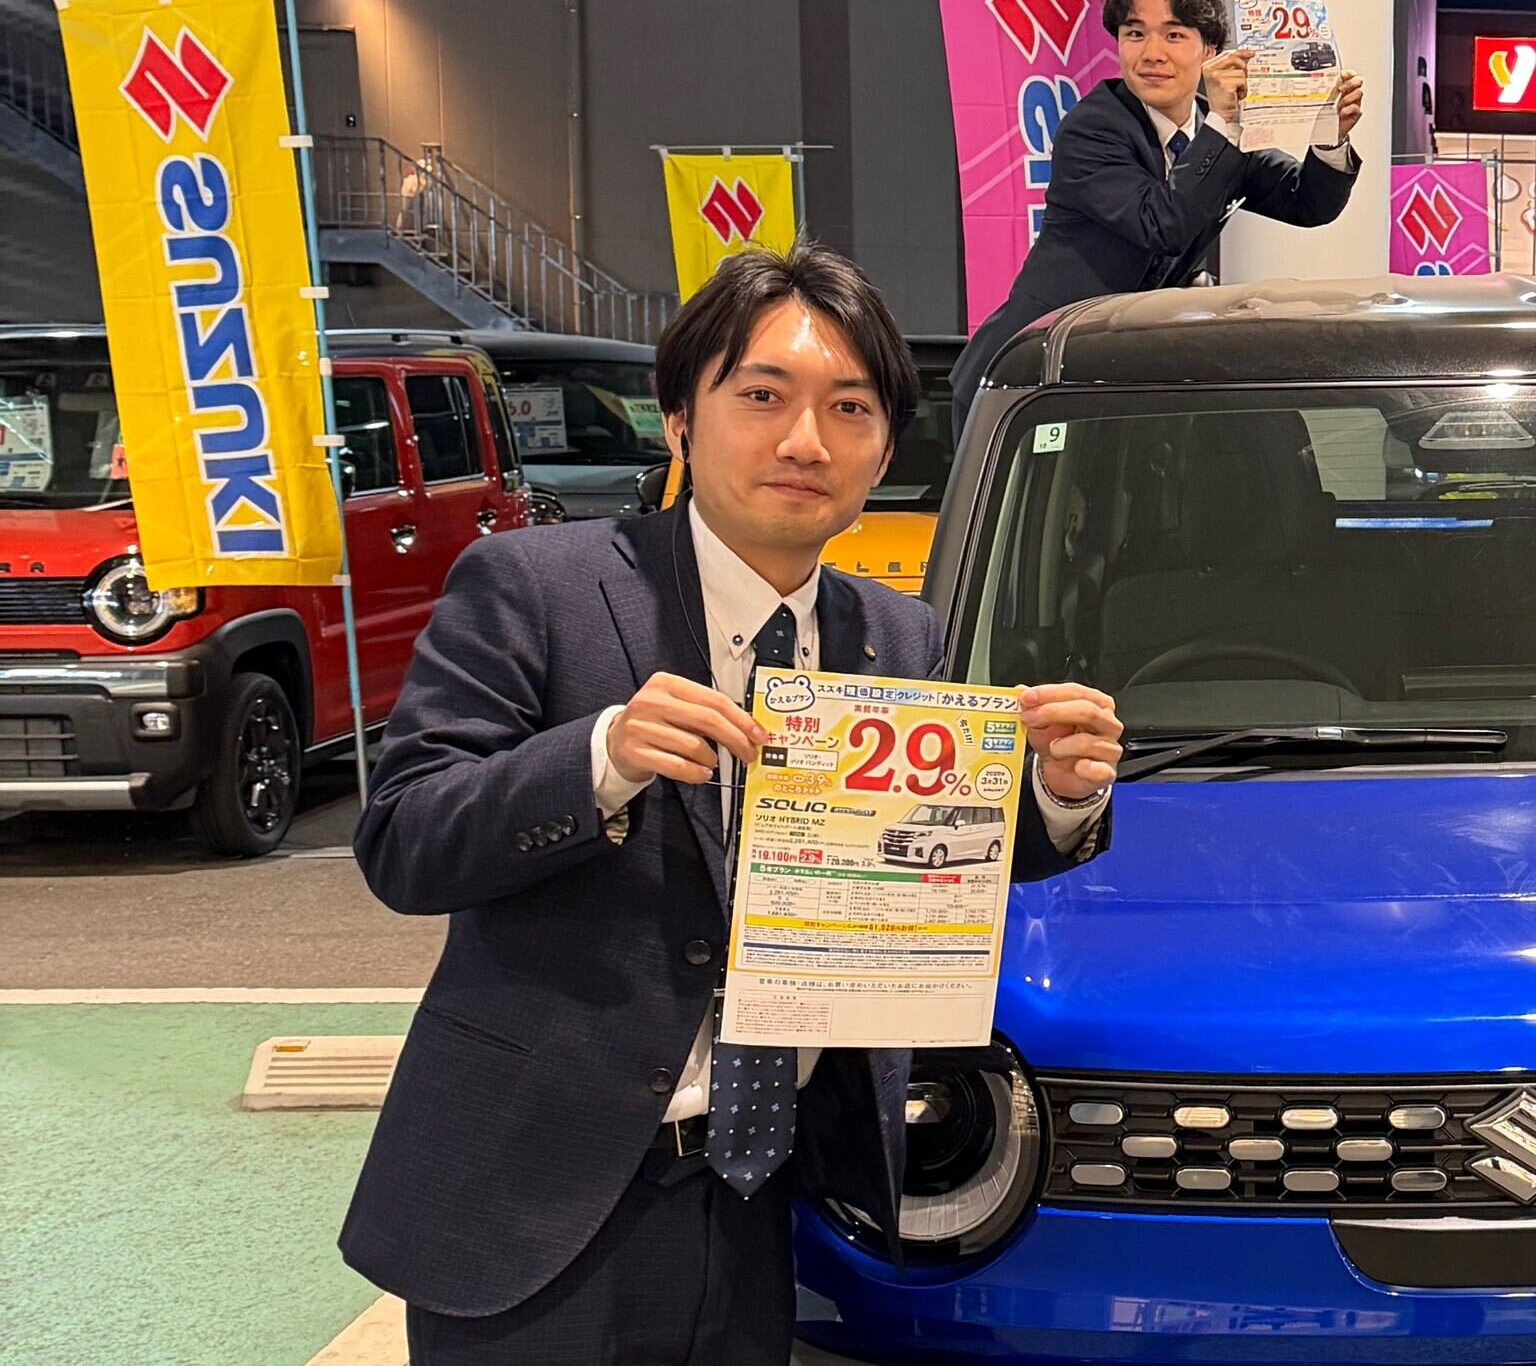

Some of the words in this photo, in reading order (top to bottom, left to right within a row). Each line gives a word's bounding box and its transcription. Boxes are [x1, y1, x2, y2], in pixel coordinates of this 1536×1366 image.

[1049, 426, 1060, 442] 9
[785, 715, 820, 733] 特別
[768, 732, 839, 748] キャンペーン
[845, 718, 971, 797] 2.9%
[756, 798, 828, 813] SOLIO
[756, 814, 778, 822] ソリオ
[779, 816, 810, 825] HYBRID
[812, 818, 826, 826] MZ
